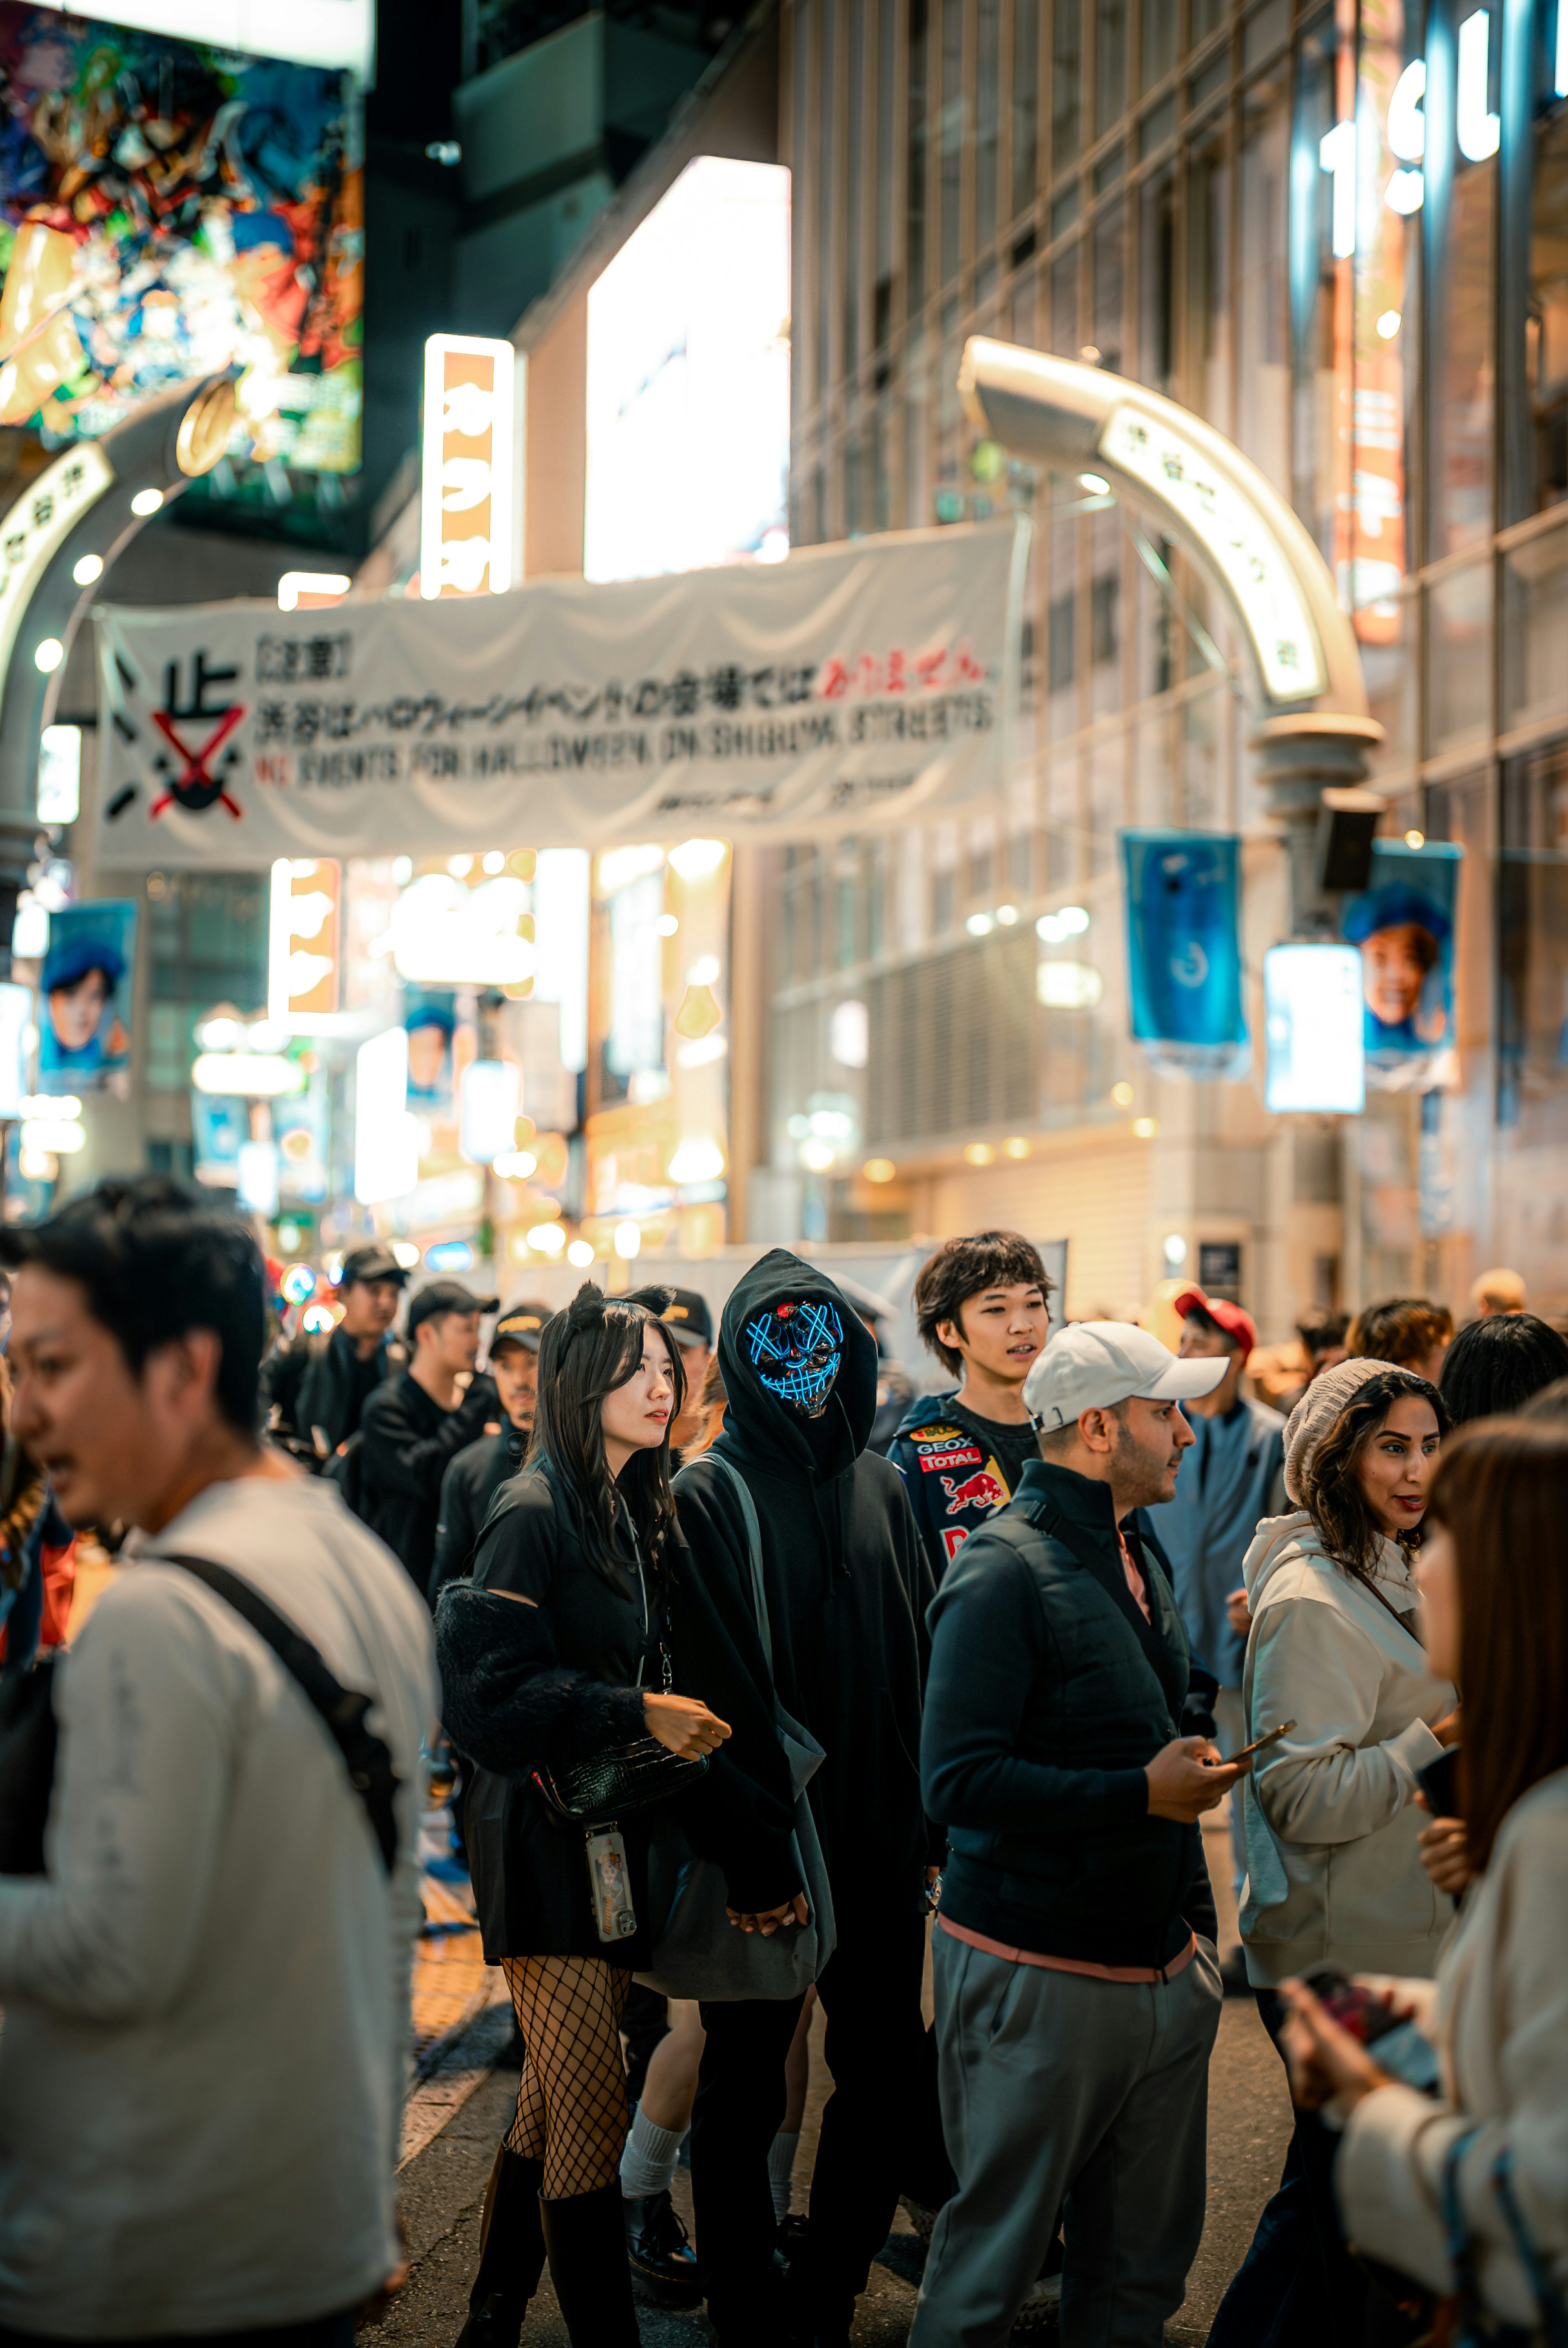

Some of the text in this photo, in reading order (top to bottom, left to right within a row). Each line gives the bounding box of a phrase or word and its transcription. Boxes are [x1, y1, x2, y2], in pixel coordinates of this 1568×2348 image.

[412, 740, 459, 778] FOR
[660, 726, 699, 763] ON
[917, 1437, 975, 1455] GEOX
[922, 1452, 980, 1469] TOTAL
